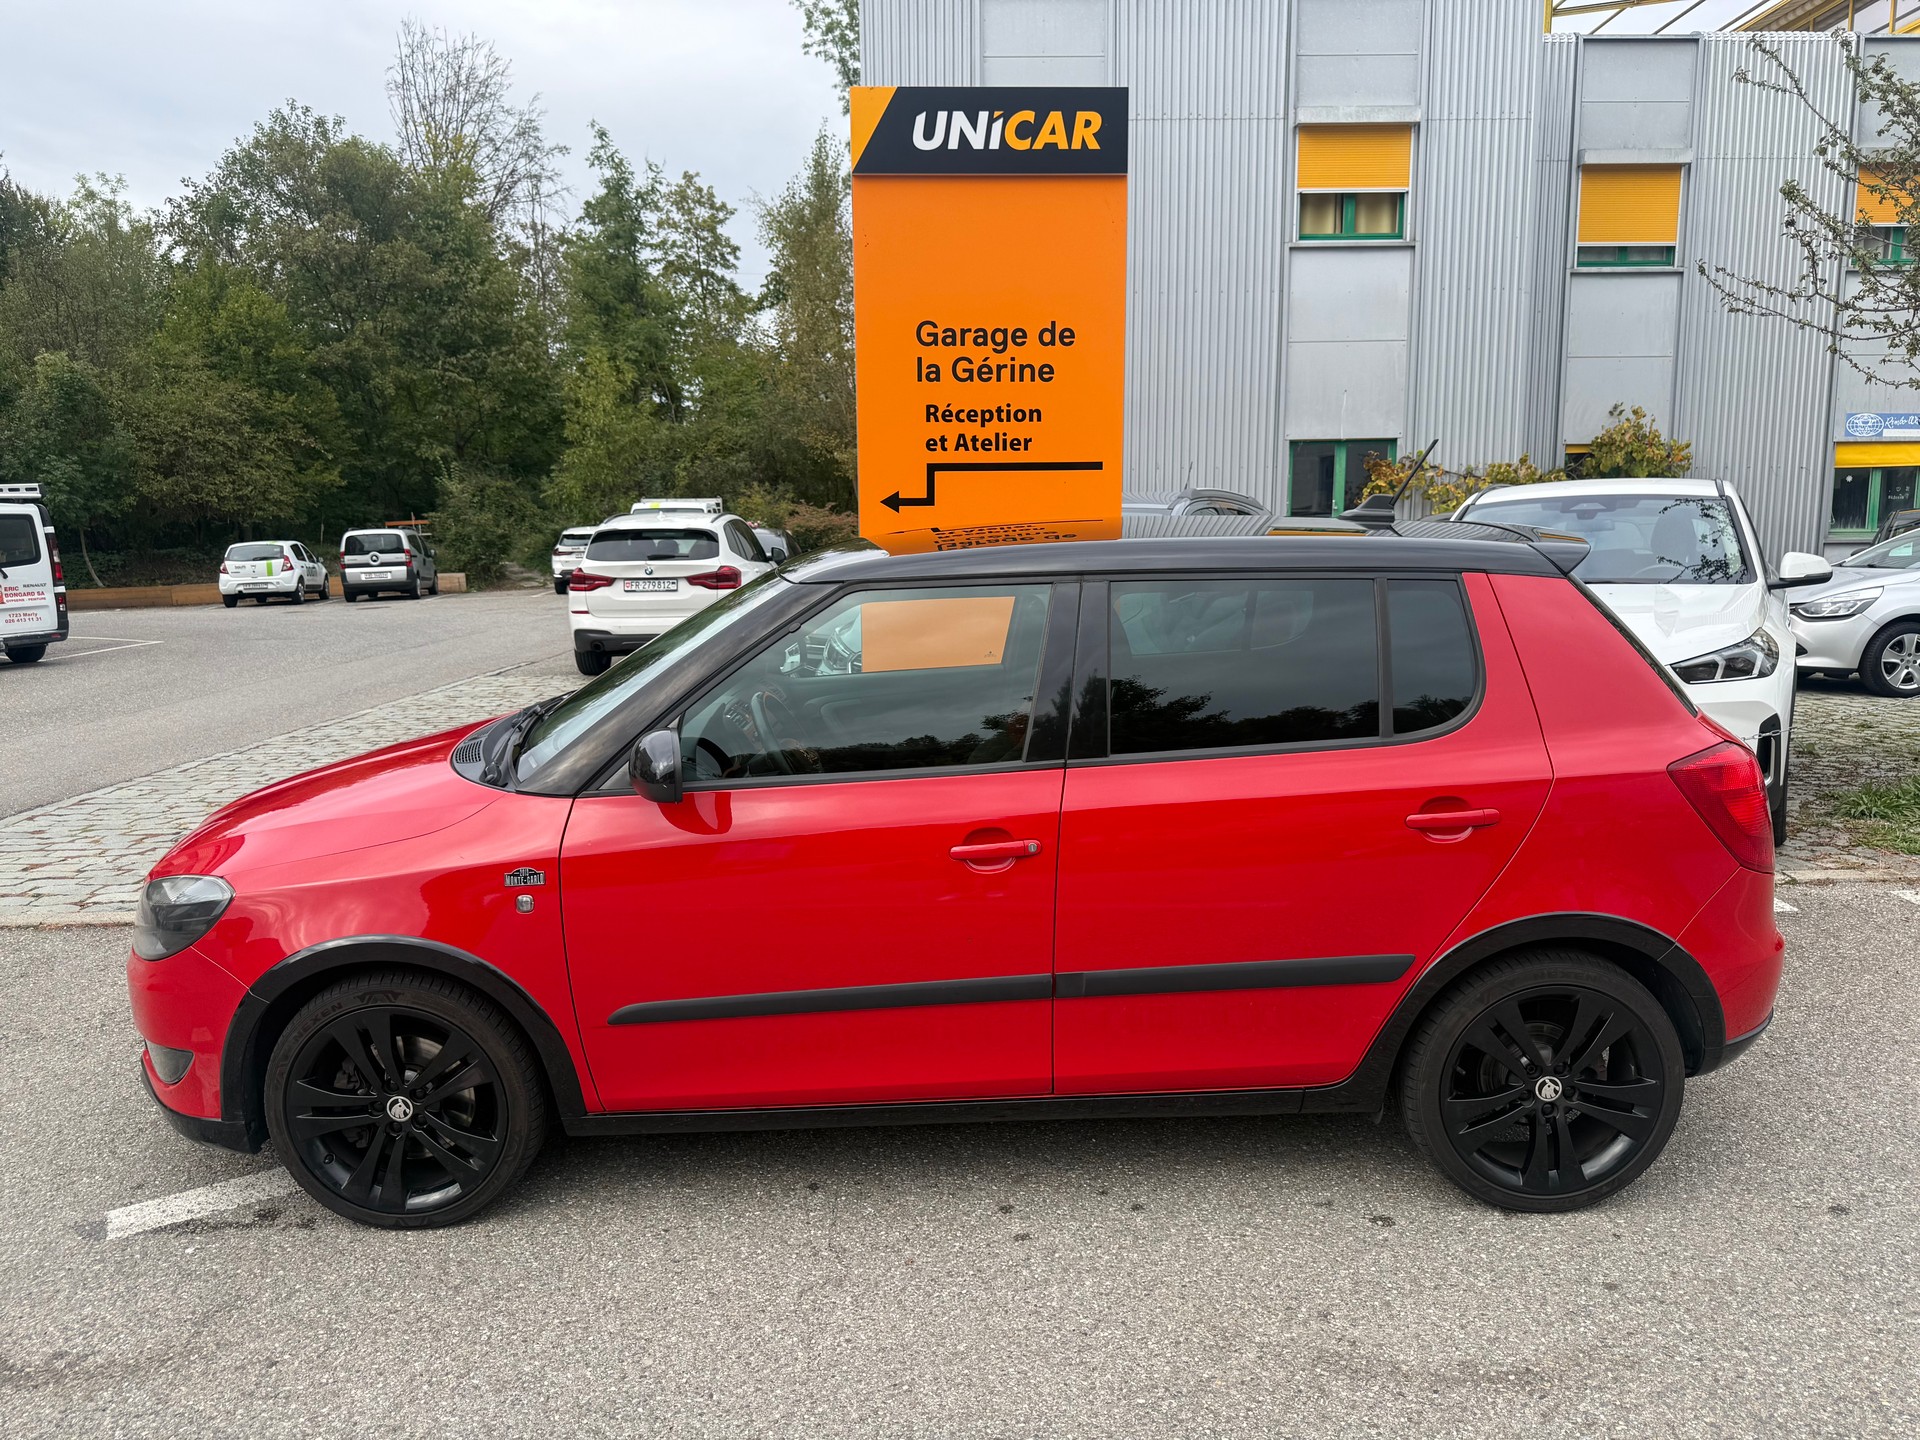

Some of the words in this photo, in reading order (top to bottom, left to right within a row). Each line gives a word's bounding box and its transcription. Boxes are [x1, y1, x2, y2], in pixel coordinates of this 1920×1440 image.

[916, 320, 1028, 354] Garage
[1038, 321, 1076, 347] de
[916, 357, 941, 382] la
[951, 356, 1055, 383] Gérine
[925, 403, 1042, 427] Réception
[925, 435, 948, 452] et
[954, 433, 1033, 452] Atelier
[293, 1002, 343, 1042] NEXEN
